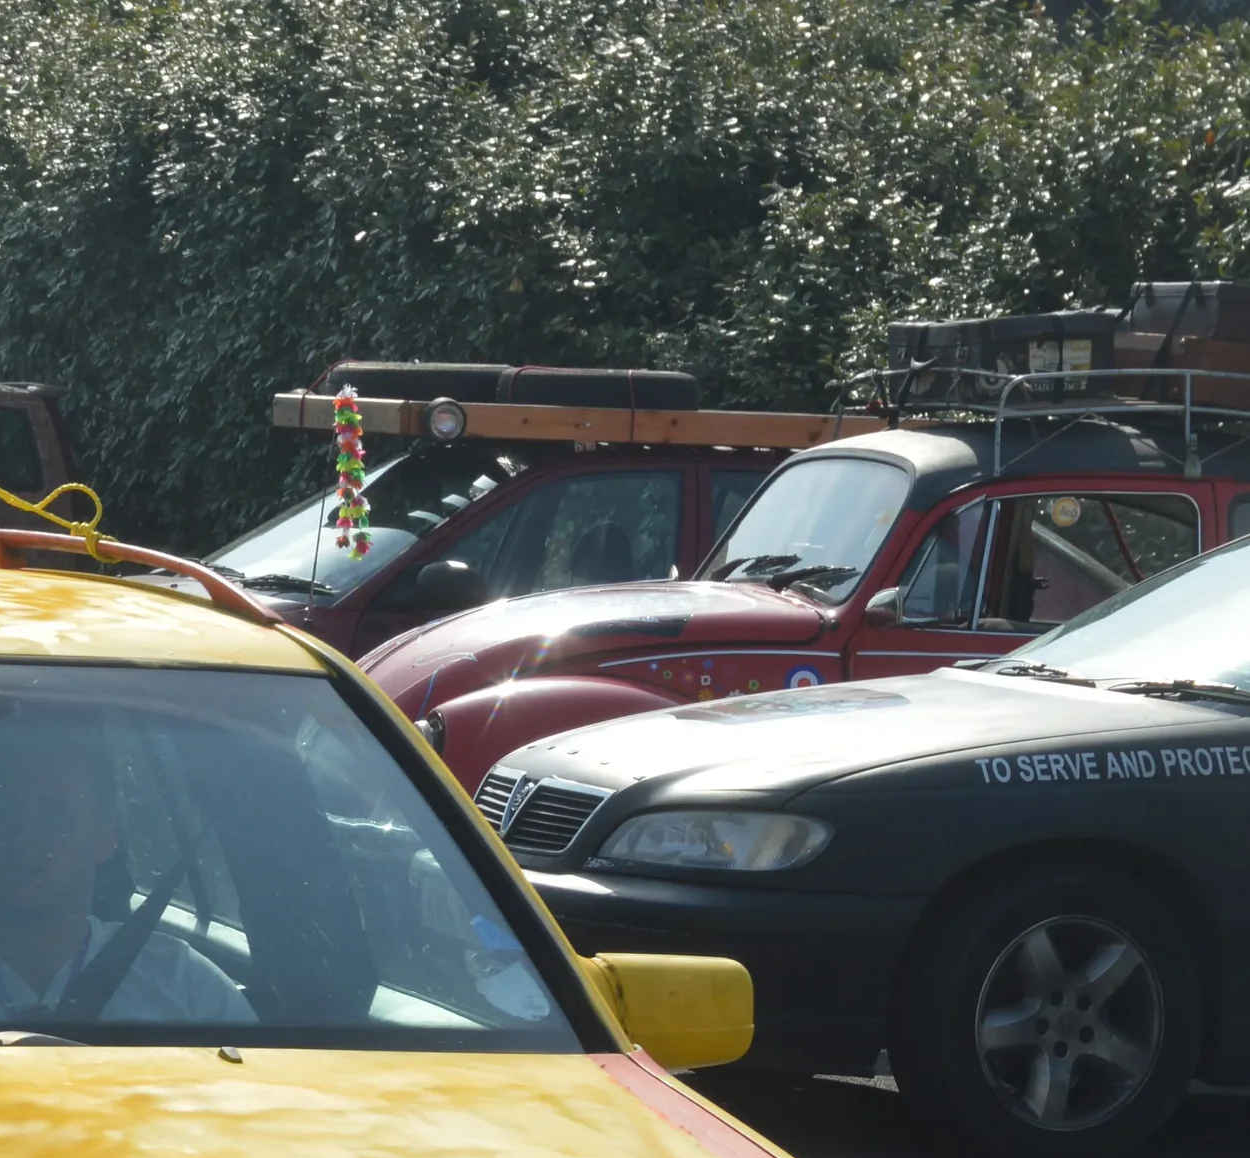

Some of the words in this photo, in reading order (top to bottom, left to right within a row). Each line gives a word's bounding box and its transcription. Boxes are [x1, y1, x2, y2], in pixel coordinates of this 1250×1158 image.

[975, 757, 1011, 784] TO
[1017, 752, 1100, 783] SERVE
[1107, 750, 1156, 780] AND
